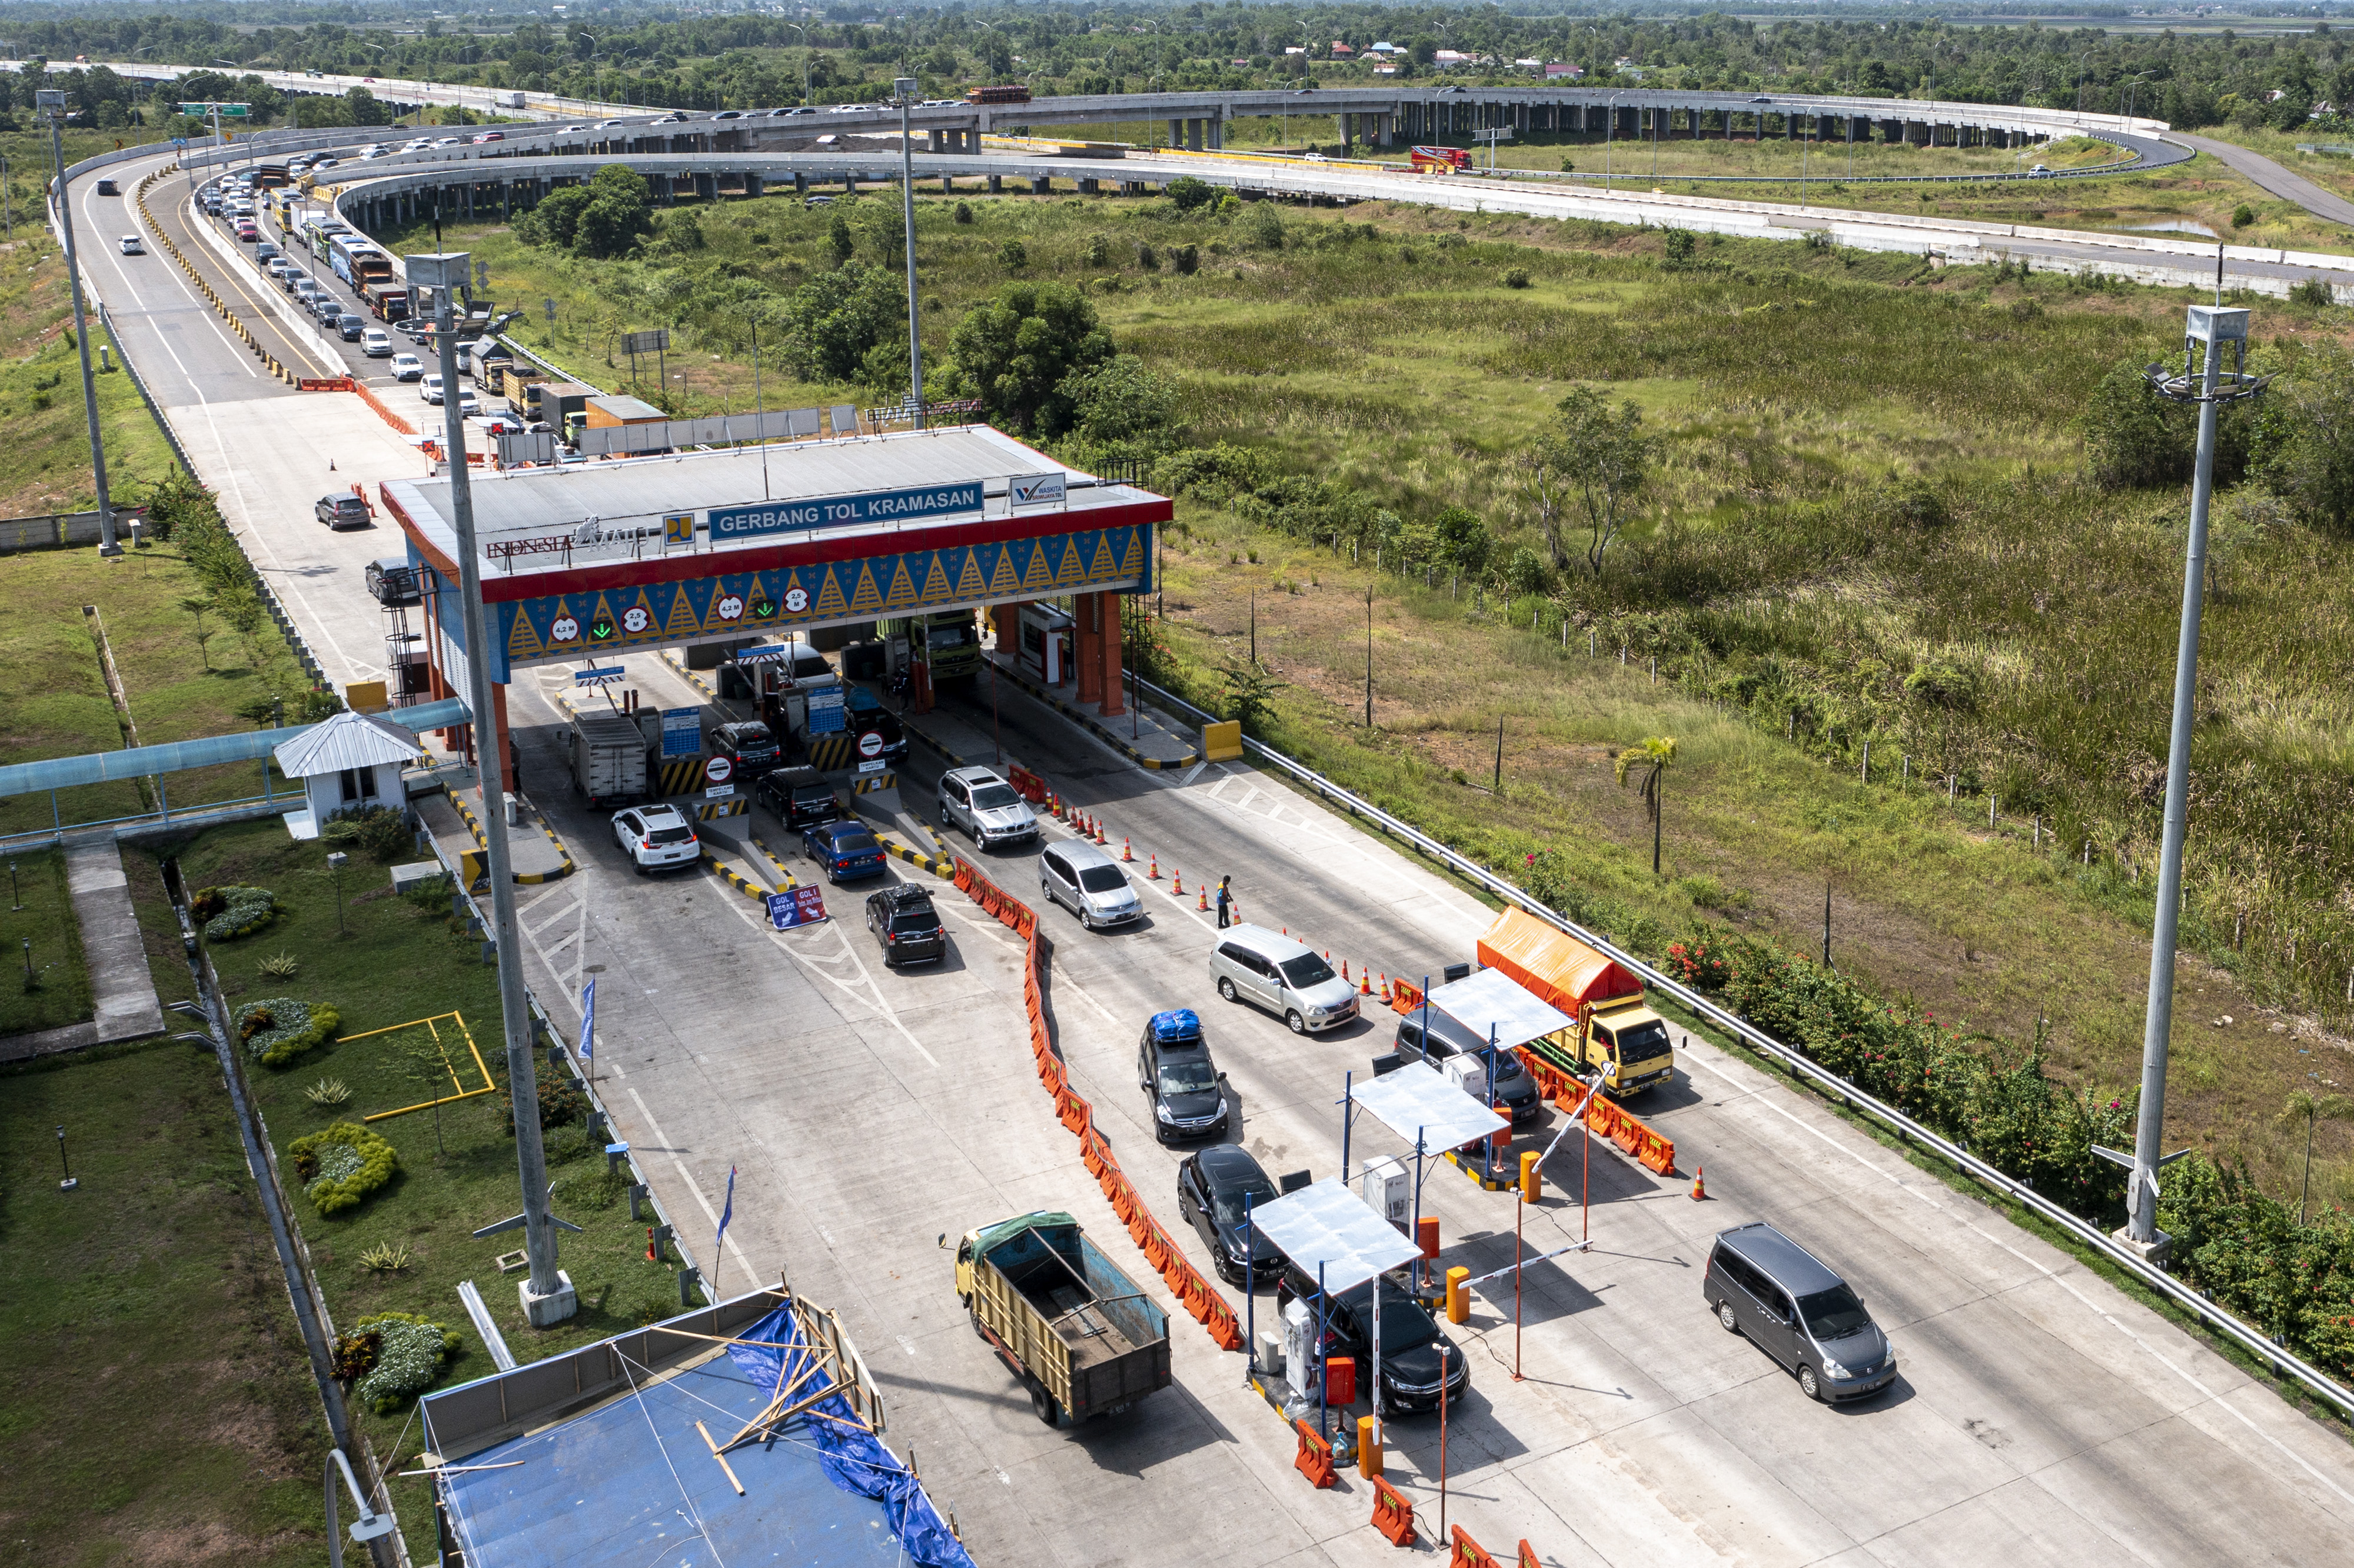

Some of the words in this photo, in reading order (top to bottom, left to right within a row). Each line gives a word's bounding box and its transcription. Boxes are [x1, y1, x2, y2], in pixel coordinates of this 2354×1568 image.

[1038, 485, 1062, 494] WASKITA
[720, 507, 819, 532] GERBANG
[824, 504, 862, 520] TOL
[868, 490, 975, 516] KRAMASAN
[486, 535, 574, 558] INDONESIA
[799, 890, 813, 898] GOL
[776, 895, 790, 905] GOL
[773, 902, 795, 914] BESAR
